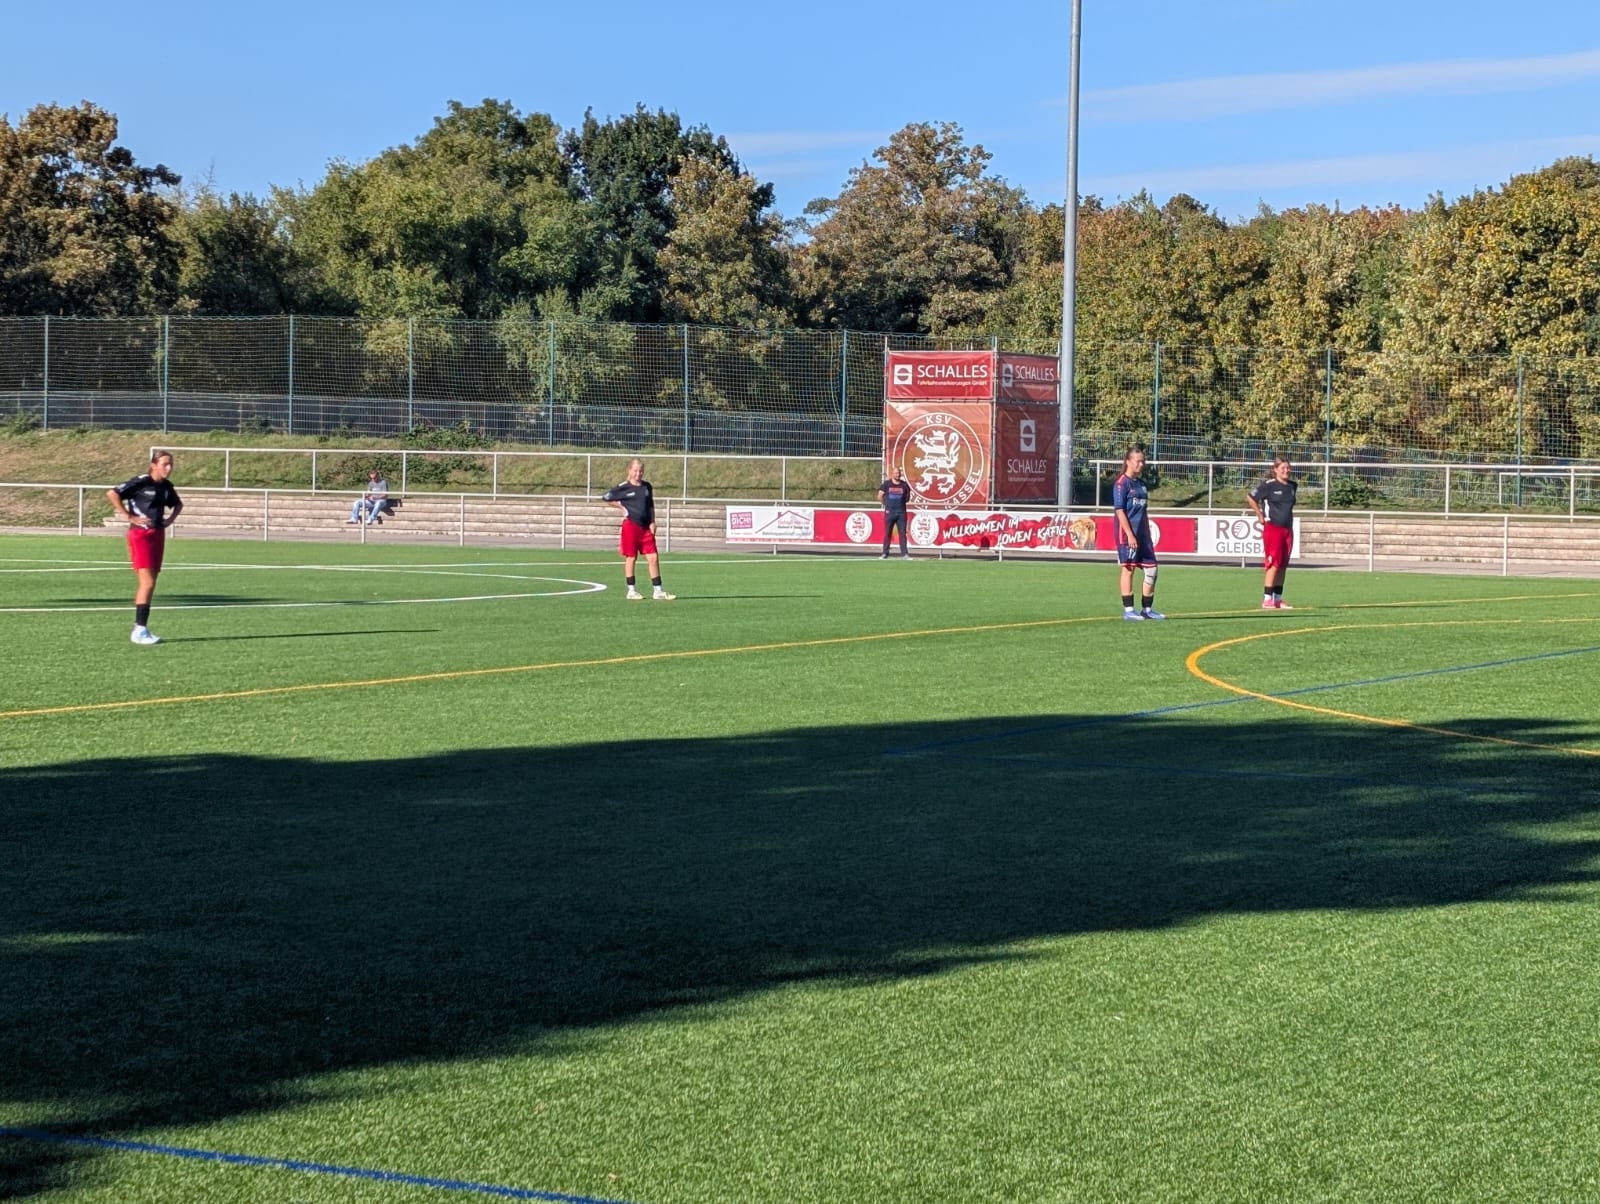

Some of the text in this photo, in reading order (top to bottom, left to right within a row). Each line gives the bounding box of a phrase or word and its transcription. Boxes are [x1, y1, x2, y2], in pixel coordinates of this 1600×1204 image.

[917, 364, 988, 379] SCHALLES
[1015, 365, 1055, 382] SCHALLES
[926, 415, 953, 425] KSV
[1007, 458, 1047, 474] SCHALLES
[942, 518, 1006, 539] WILLKOMMEN
[1008, 516, 1019, 529] IM
[1216, 541, 1265, 554] GLEISB
